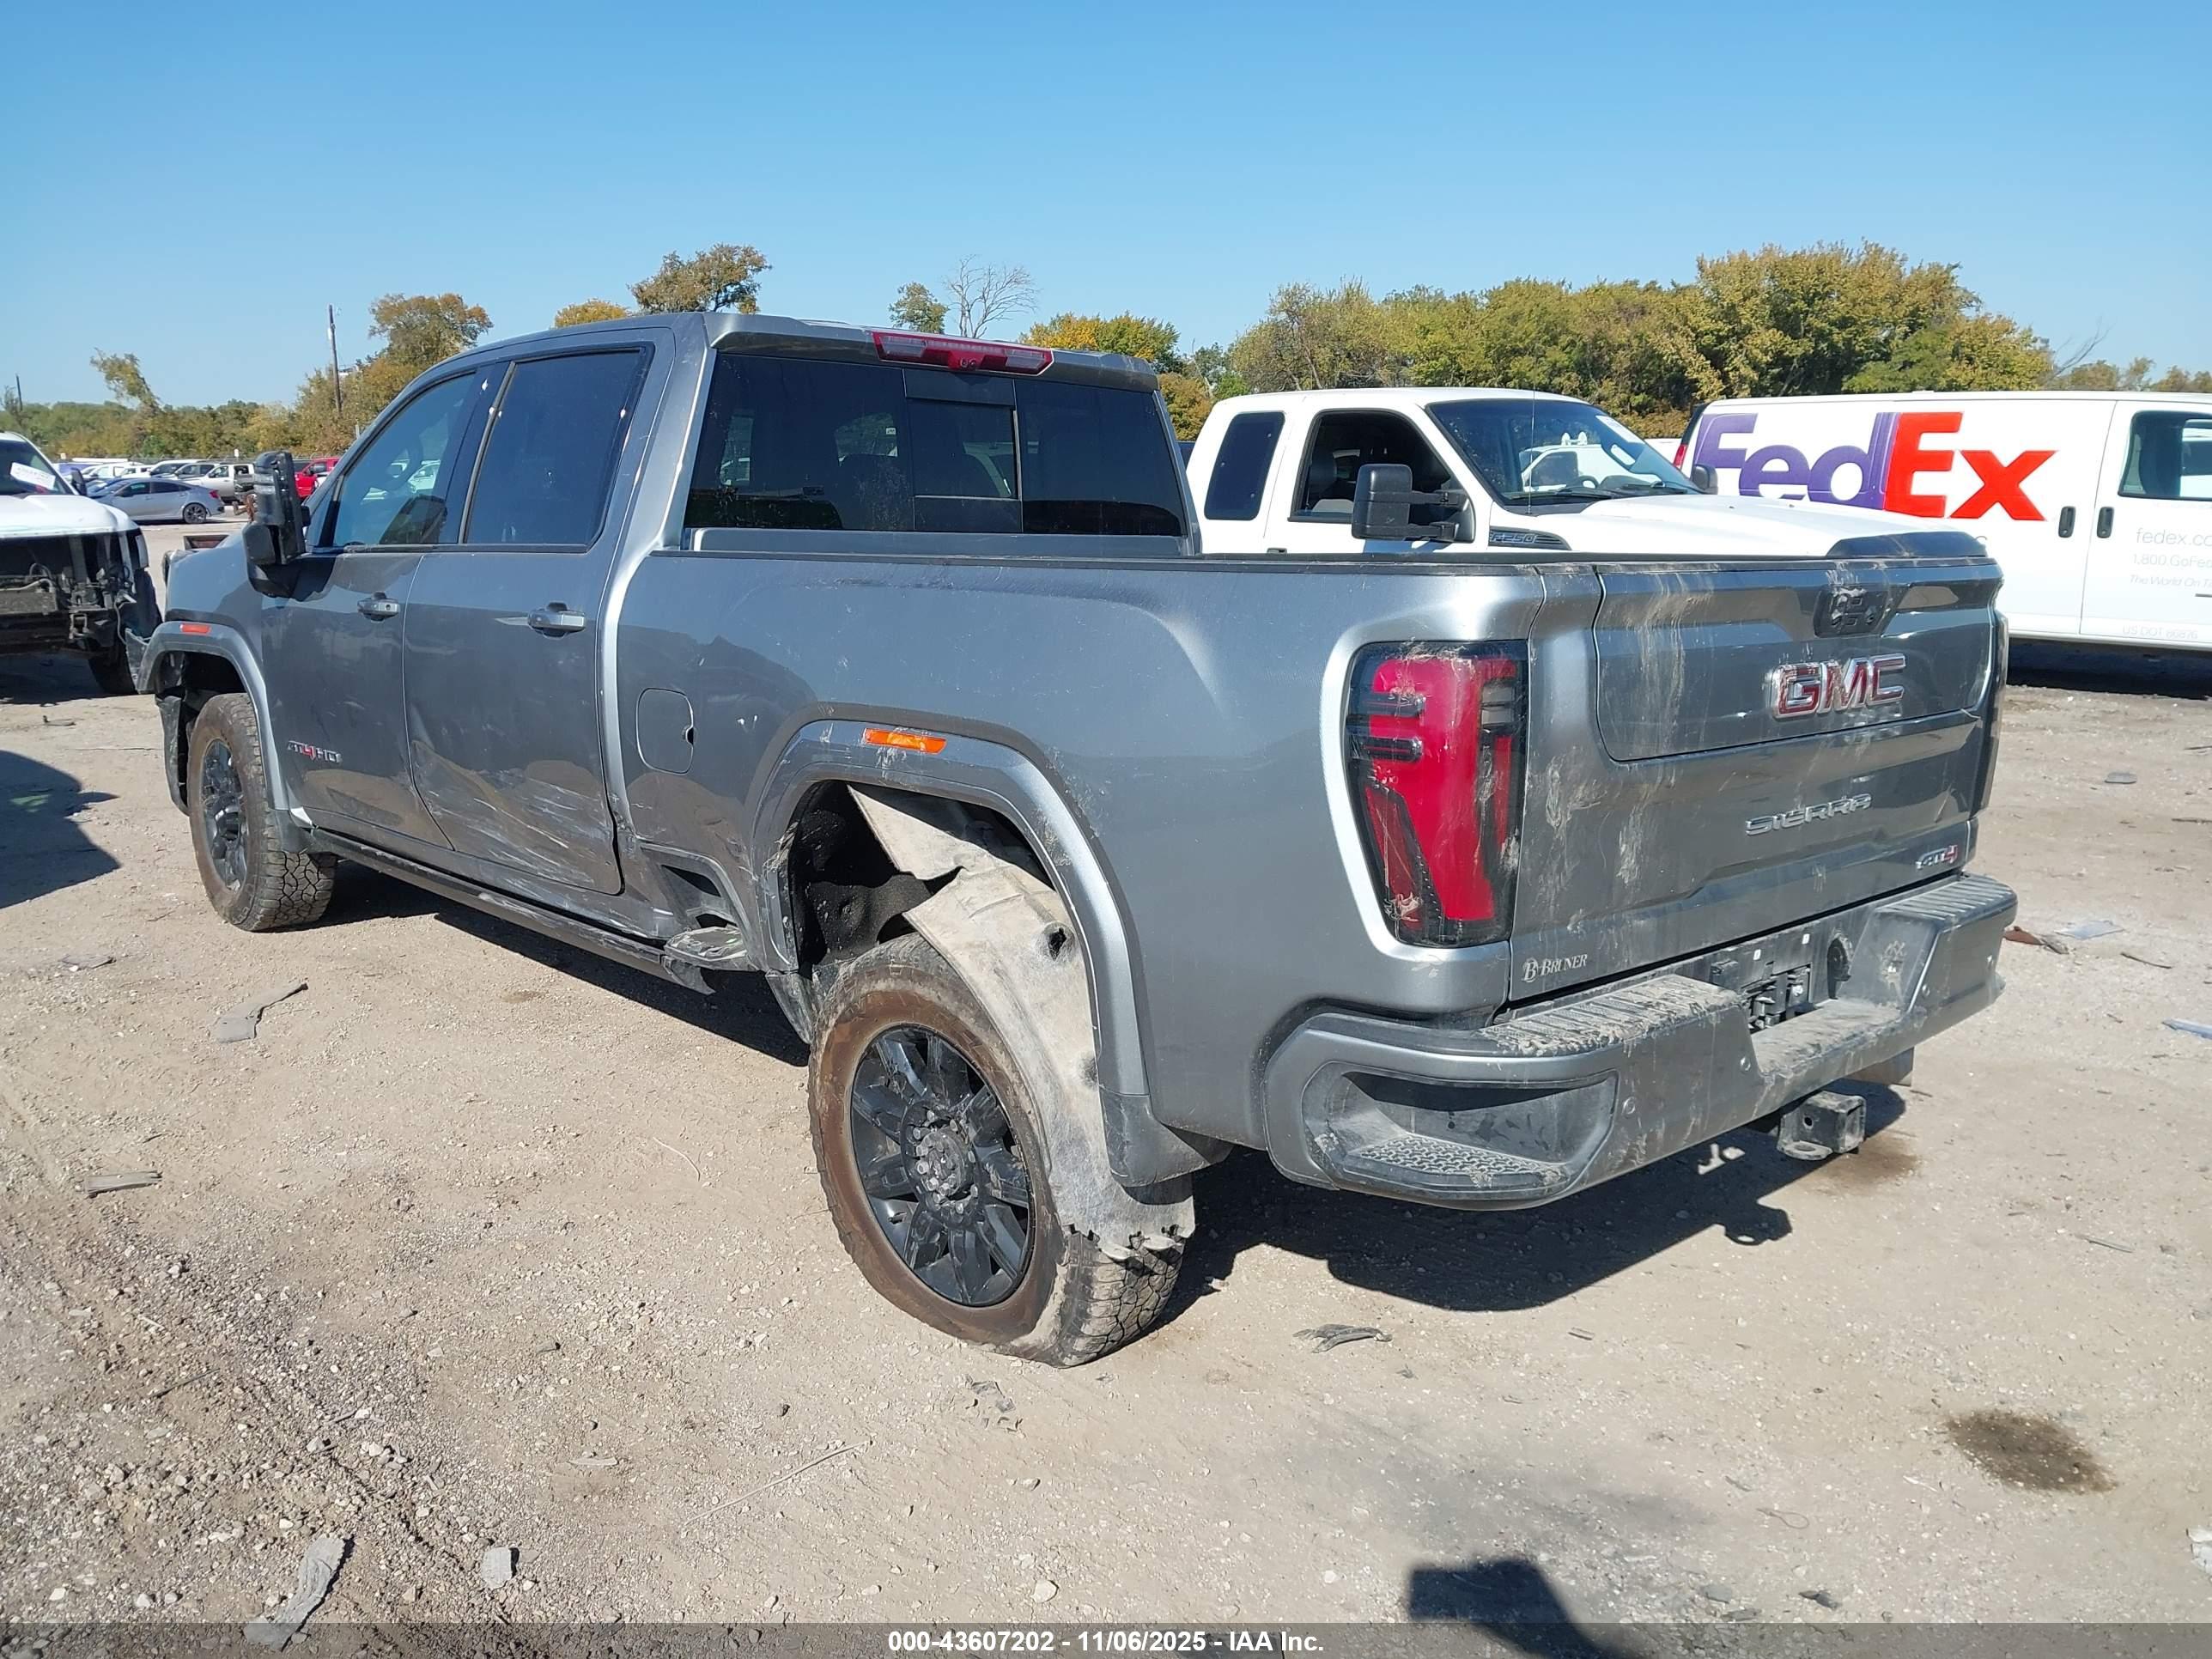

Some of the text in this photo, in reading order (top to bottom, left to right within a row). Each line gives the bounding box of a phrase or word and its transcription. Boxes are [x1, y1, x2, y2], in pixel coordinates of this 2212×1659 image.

[1693, 411, 2059, 520] FedEx
[1771, 653, 1906, 719] GMC
[1745, 793, 1872, 836] SIERRA
